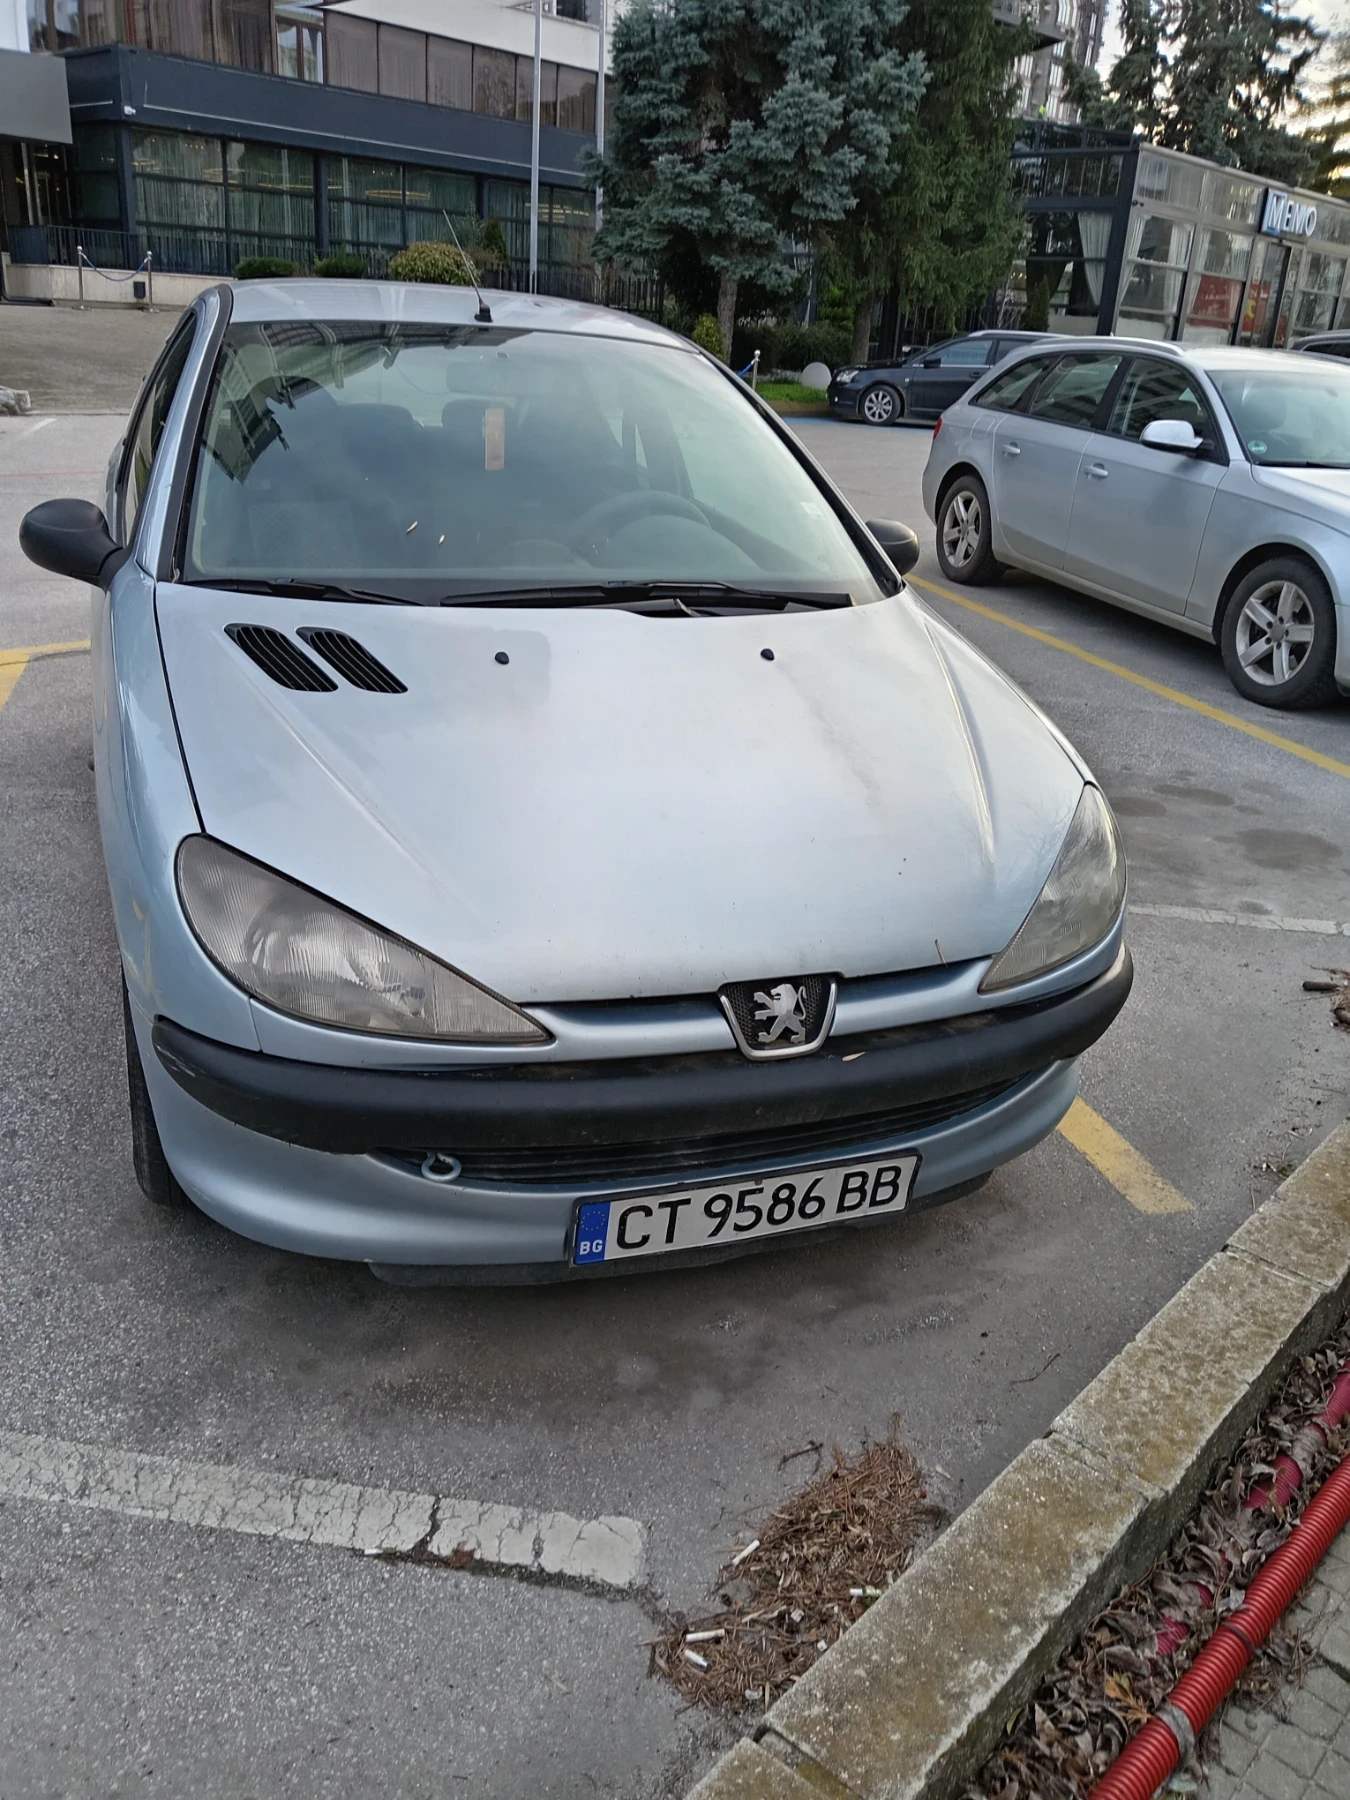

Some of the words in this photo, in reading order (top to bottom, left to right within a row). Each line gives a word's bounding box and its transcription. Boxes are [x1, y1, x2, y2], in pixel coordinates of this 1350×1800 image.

[1267, 195, 1317, 237] MEMO
[616, 1198, 692, 1250] CT
[703, 1177, 826, 1238] 9586
[835, 1165, 903, 1214] BB
[579, 1239, 603, 1255] BG
